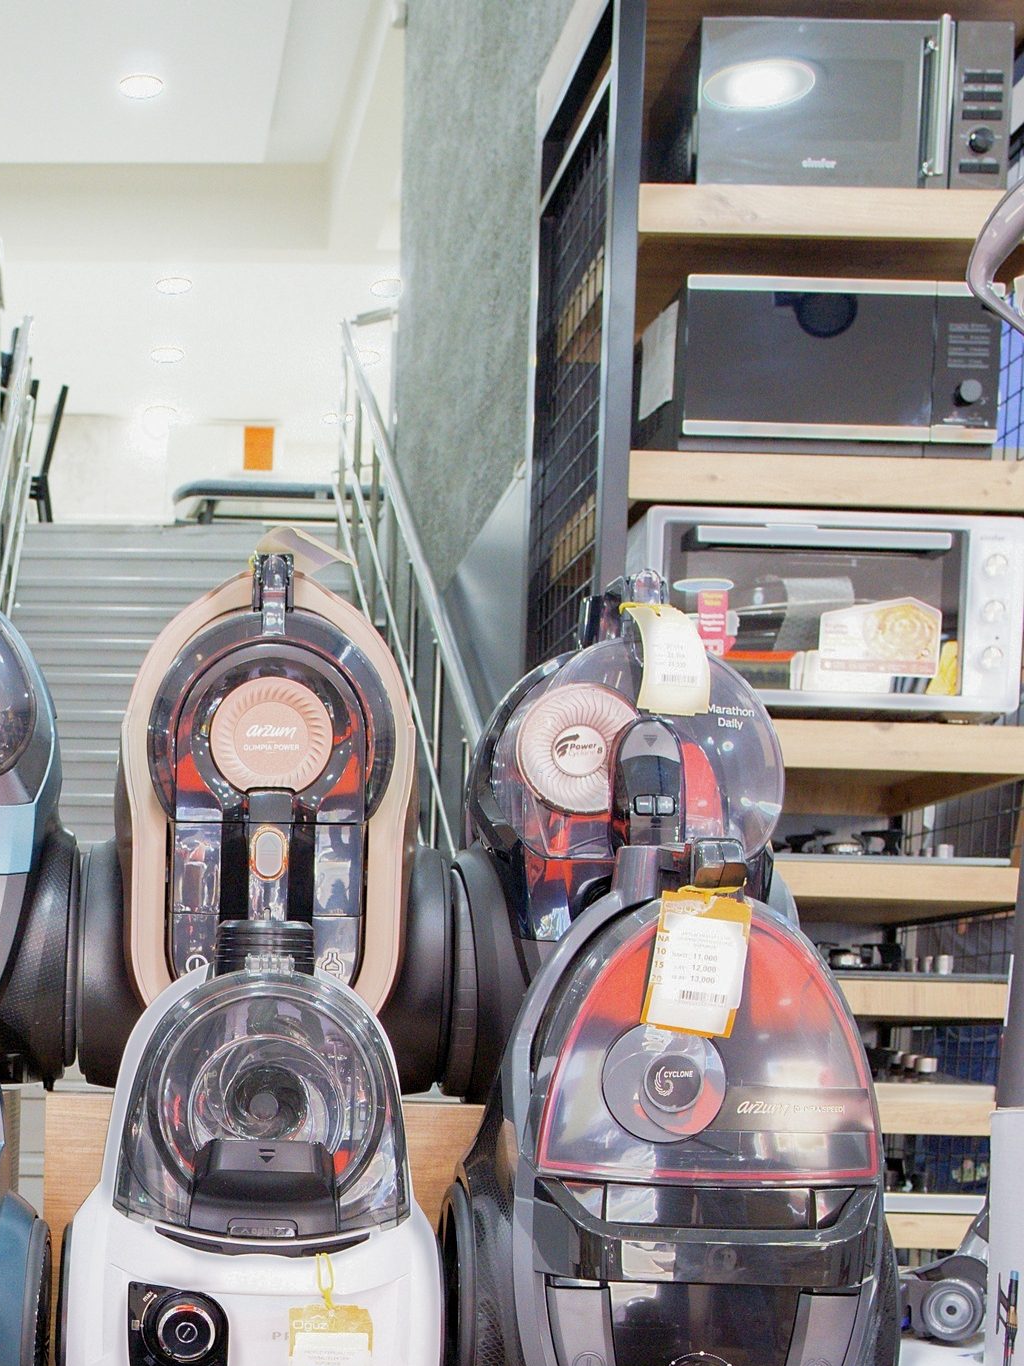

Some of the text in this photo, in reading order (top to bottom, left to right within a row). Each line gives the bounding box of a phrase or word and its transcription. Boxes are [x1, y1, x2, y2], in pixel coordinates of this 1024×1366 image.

[707, 703, 755, 718] Marathon
[717, 716, 744, 731] Daily
[246, 724, 297, 740] arzum
[664, 1070, 694, 1079] CYCLONE
